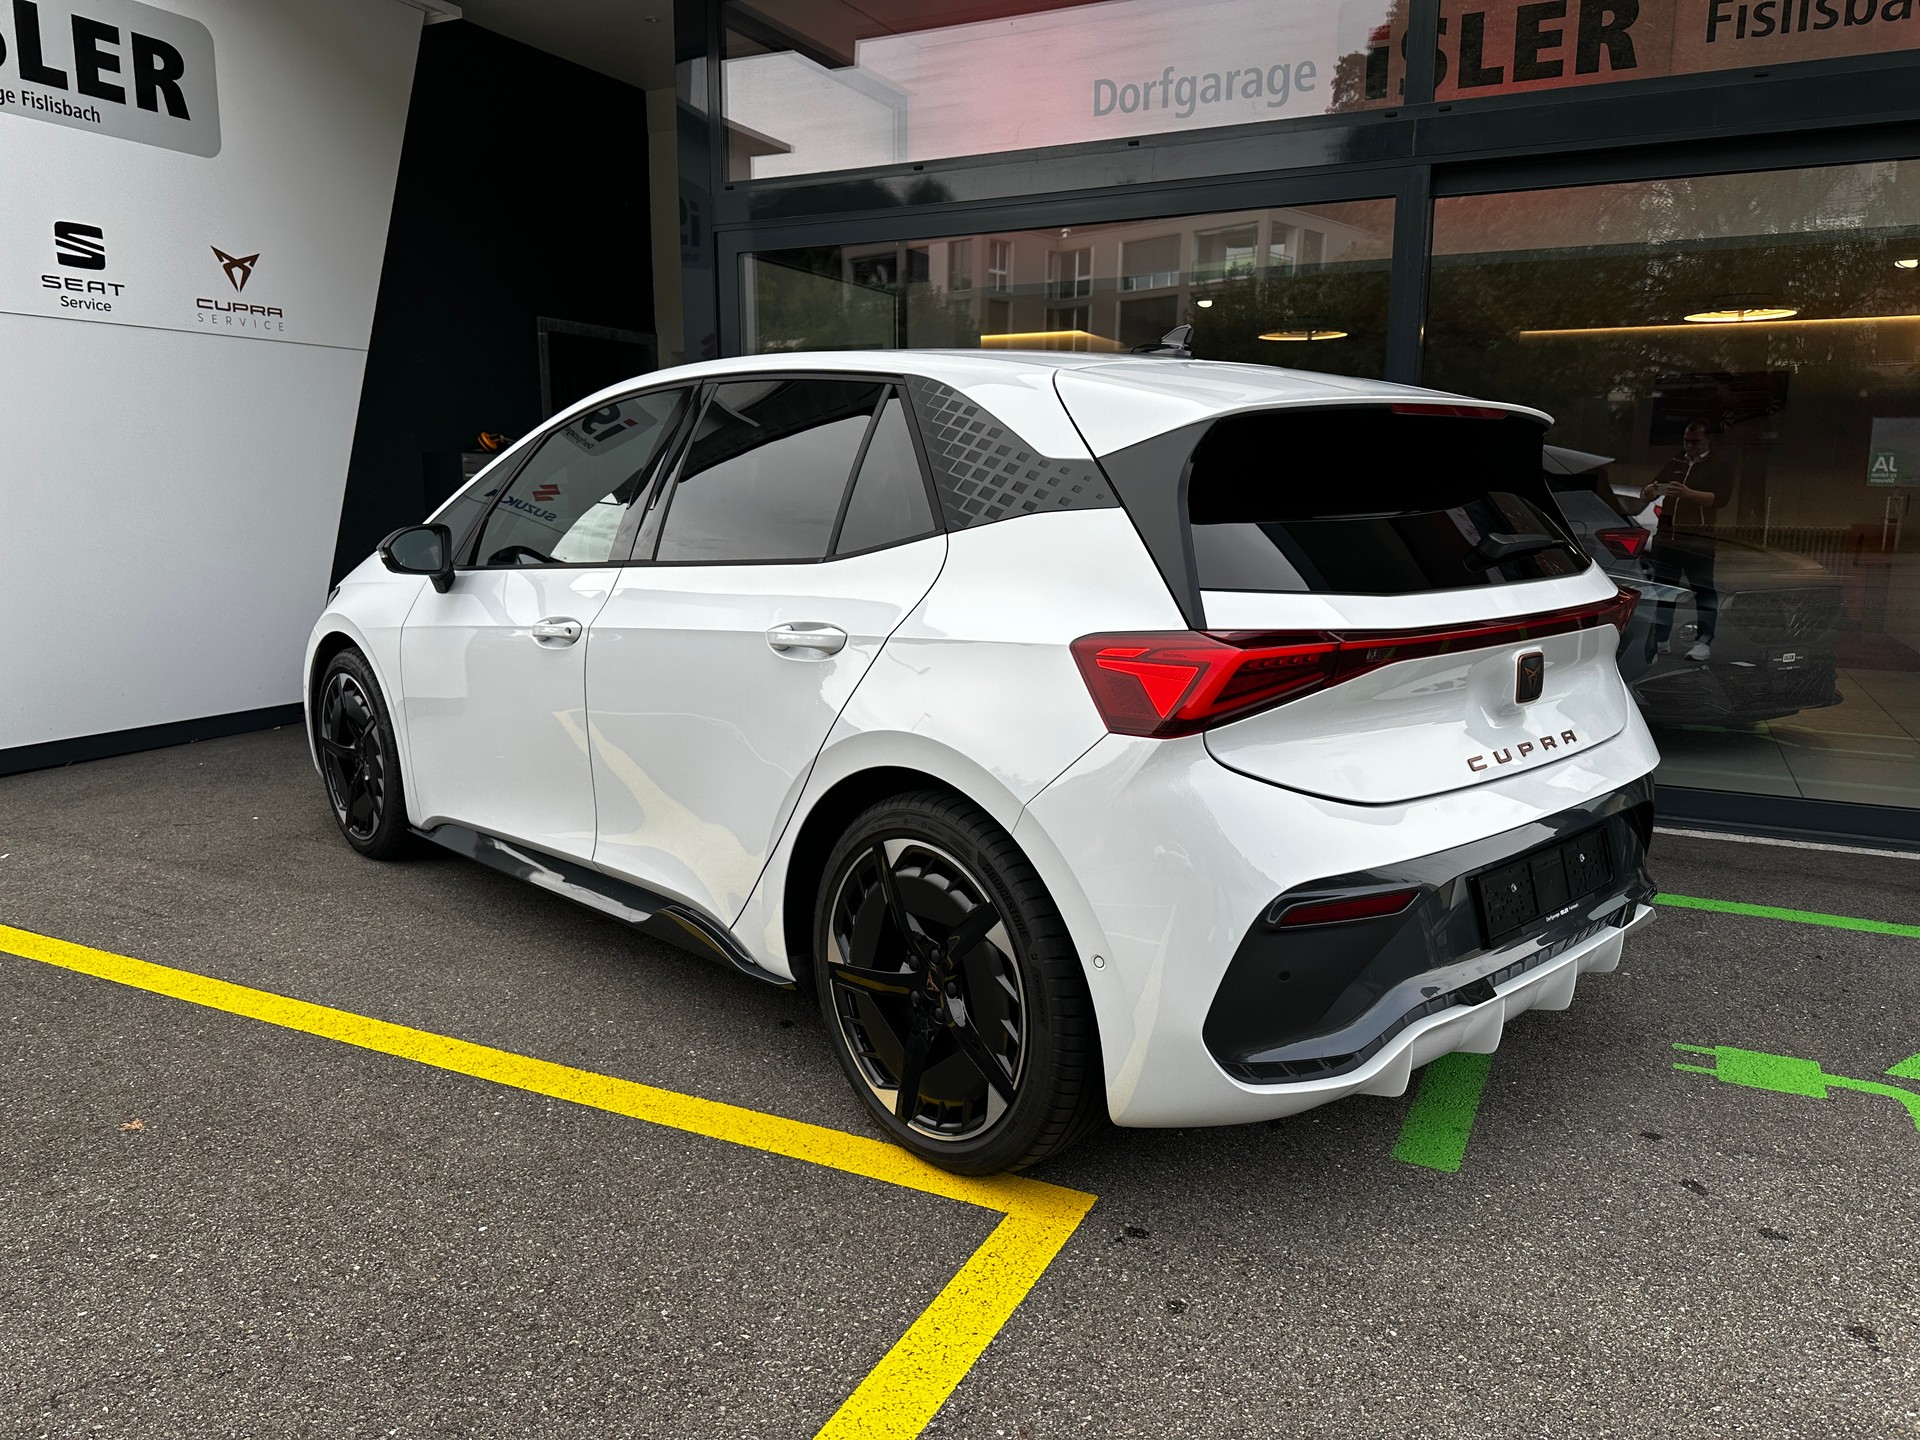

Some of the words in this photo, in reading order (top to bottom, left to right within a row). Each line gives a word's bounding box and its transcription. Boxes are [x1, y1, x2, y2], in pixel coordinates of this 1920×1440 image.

[0, 0, 191, 121] LER
[1093, 60, 1317, 119] Dorfgarage
[1706, 0, 1920, 43] Fislisba
[21, 90, 101, 124] Fislisbach
[41, 274, 125, 296] SEAT
[60, 295, 112, 312] Service
[196, 298, 283, 318] CUPRA
[198, 312, 285, 332] SERVICE
[1467, 729, 1578, 772] CUPRA
[983, 863, 1029, 938] BRIDGESTONE
